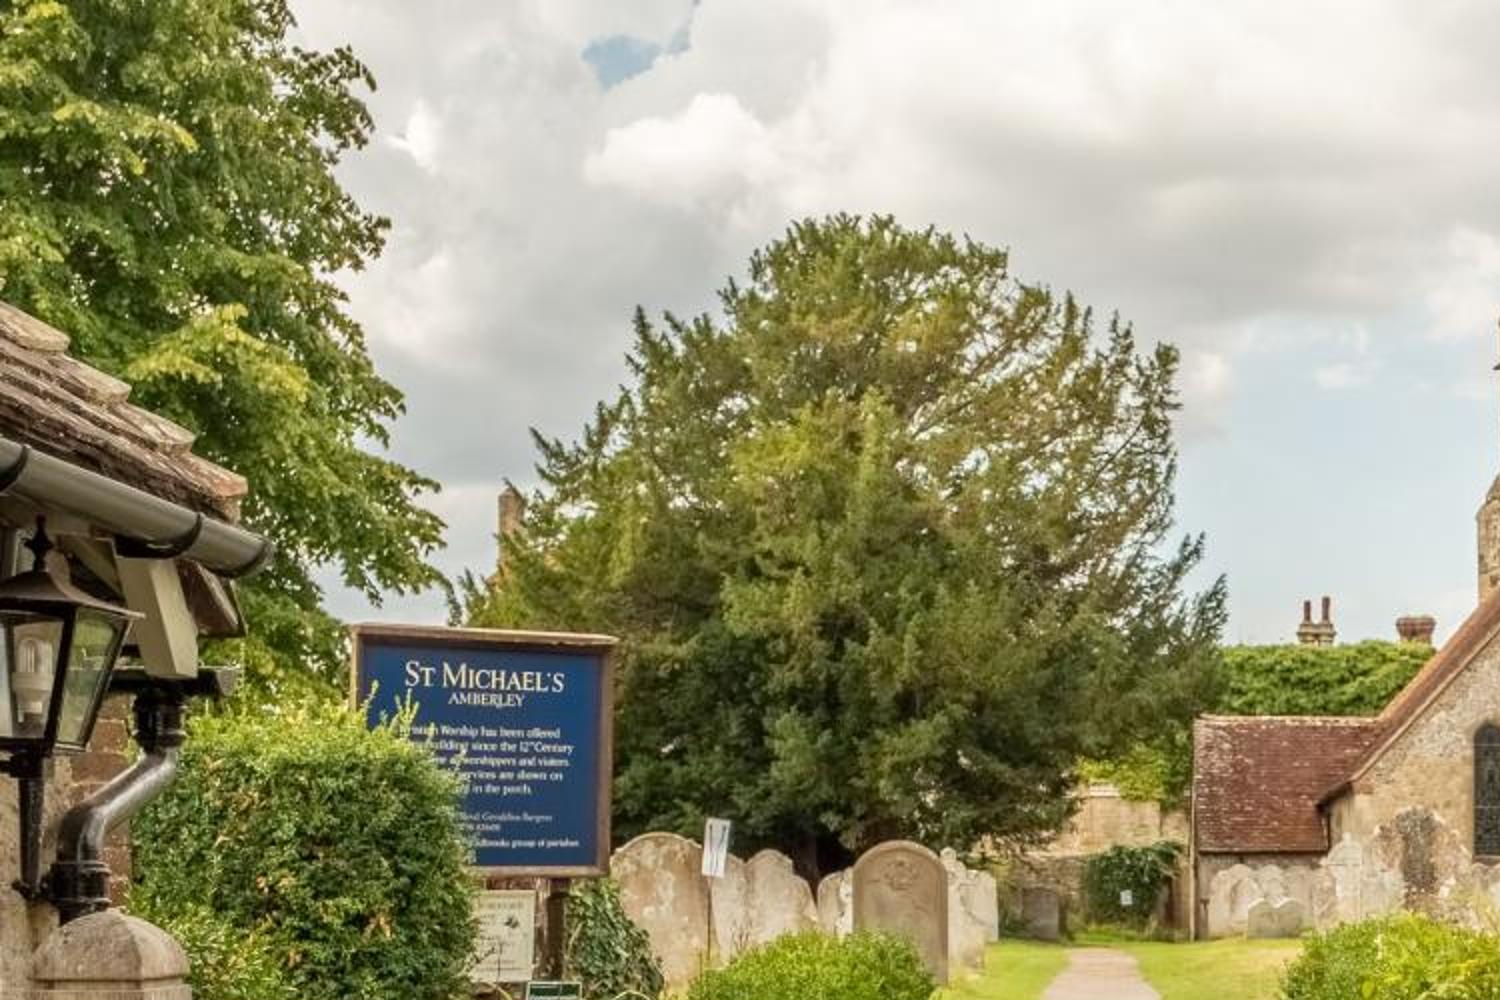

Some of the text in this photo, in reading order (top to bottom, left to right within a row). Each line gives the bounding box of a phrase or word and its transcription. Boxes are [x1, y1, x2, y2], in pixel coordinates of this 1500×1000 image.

[448, 691, 525, 708] AMBERLEY
[481, 725, 498, 737] has
[499, 726, 525, 738] been
[526, 727, 561, 739] offered
[471, 742, 498, 751] since
[500, 742, 517, 753] the
[534, 741, 575, 756] Century
[518, 756, 537, 767] and
[499, 771, 515, 781] are
[517, 769, 547, 781] shown
[549, 771, 564, 782] on
[485, 783, 501, 794] the
